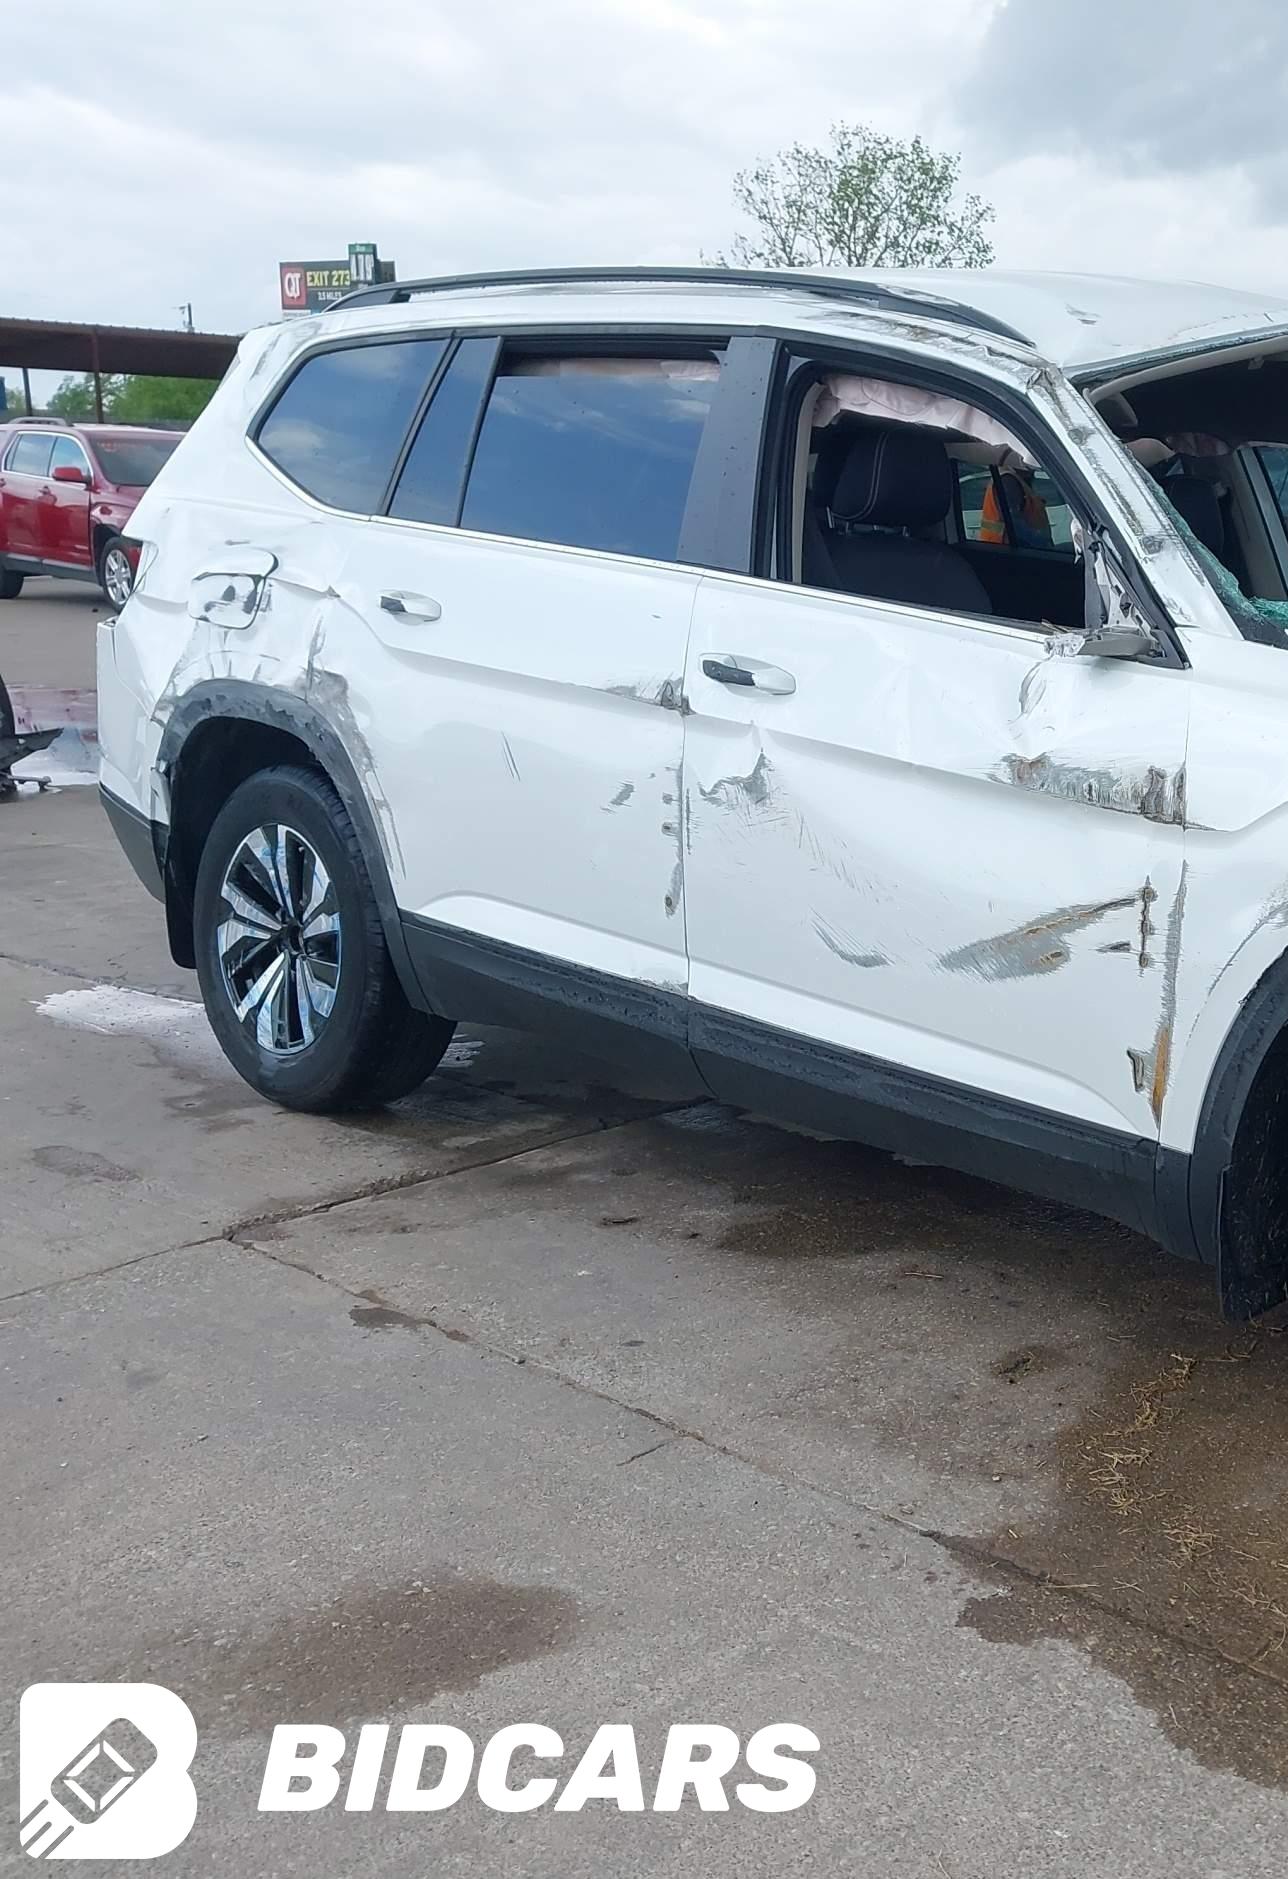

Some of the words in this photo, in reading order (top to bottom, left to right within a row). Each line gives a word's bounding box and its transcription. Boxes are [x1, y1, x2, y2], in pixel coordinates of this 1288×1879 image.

[285, 272, 301, 300] QT
[306, 271, 329, 287] EXIT
[331, 270, 351, 286] 273
